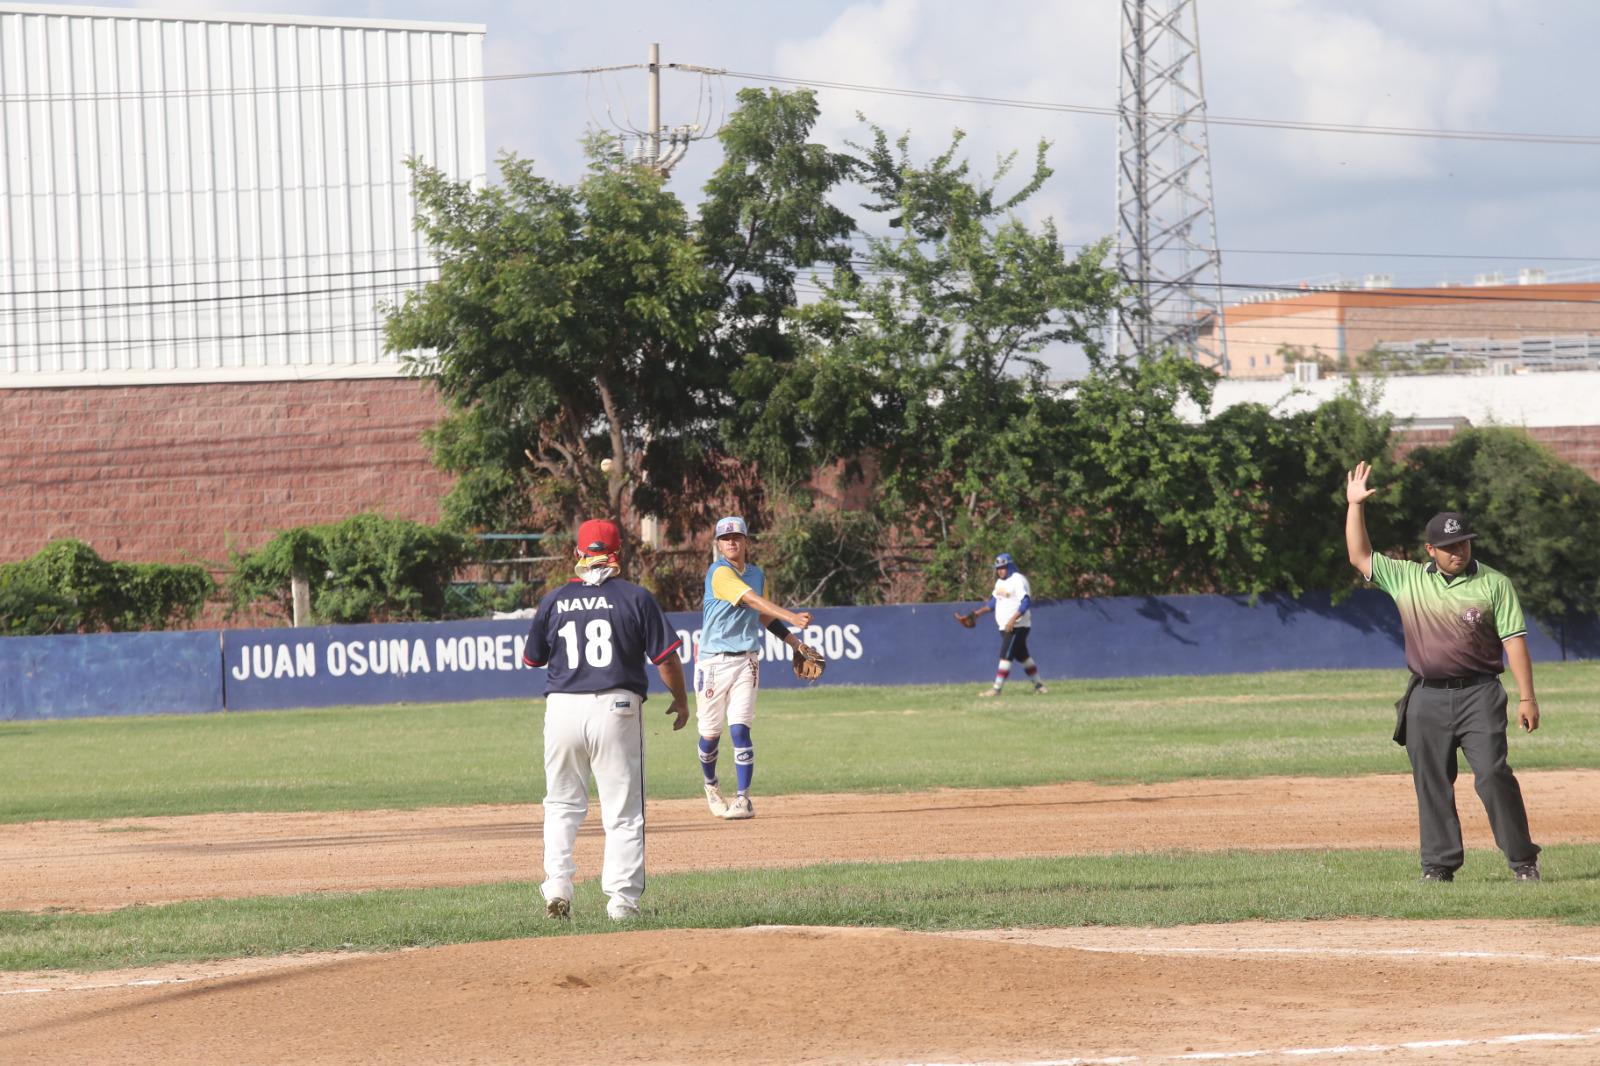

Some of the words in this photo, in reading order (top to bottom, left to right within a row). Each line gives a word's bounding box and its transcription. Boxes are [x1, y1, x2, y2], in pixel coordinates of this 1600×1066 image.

[231, 641, 316, 681] JUAN
[326, 638, 431, 677] OSUNA
[557, 618, 613, 670] 18
